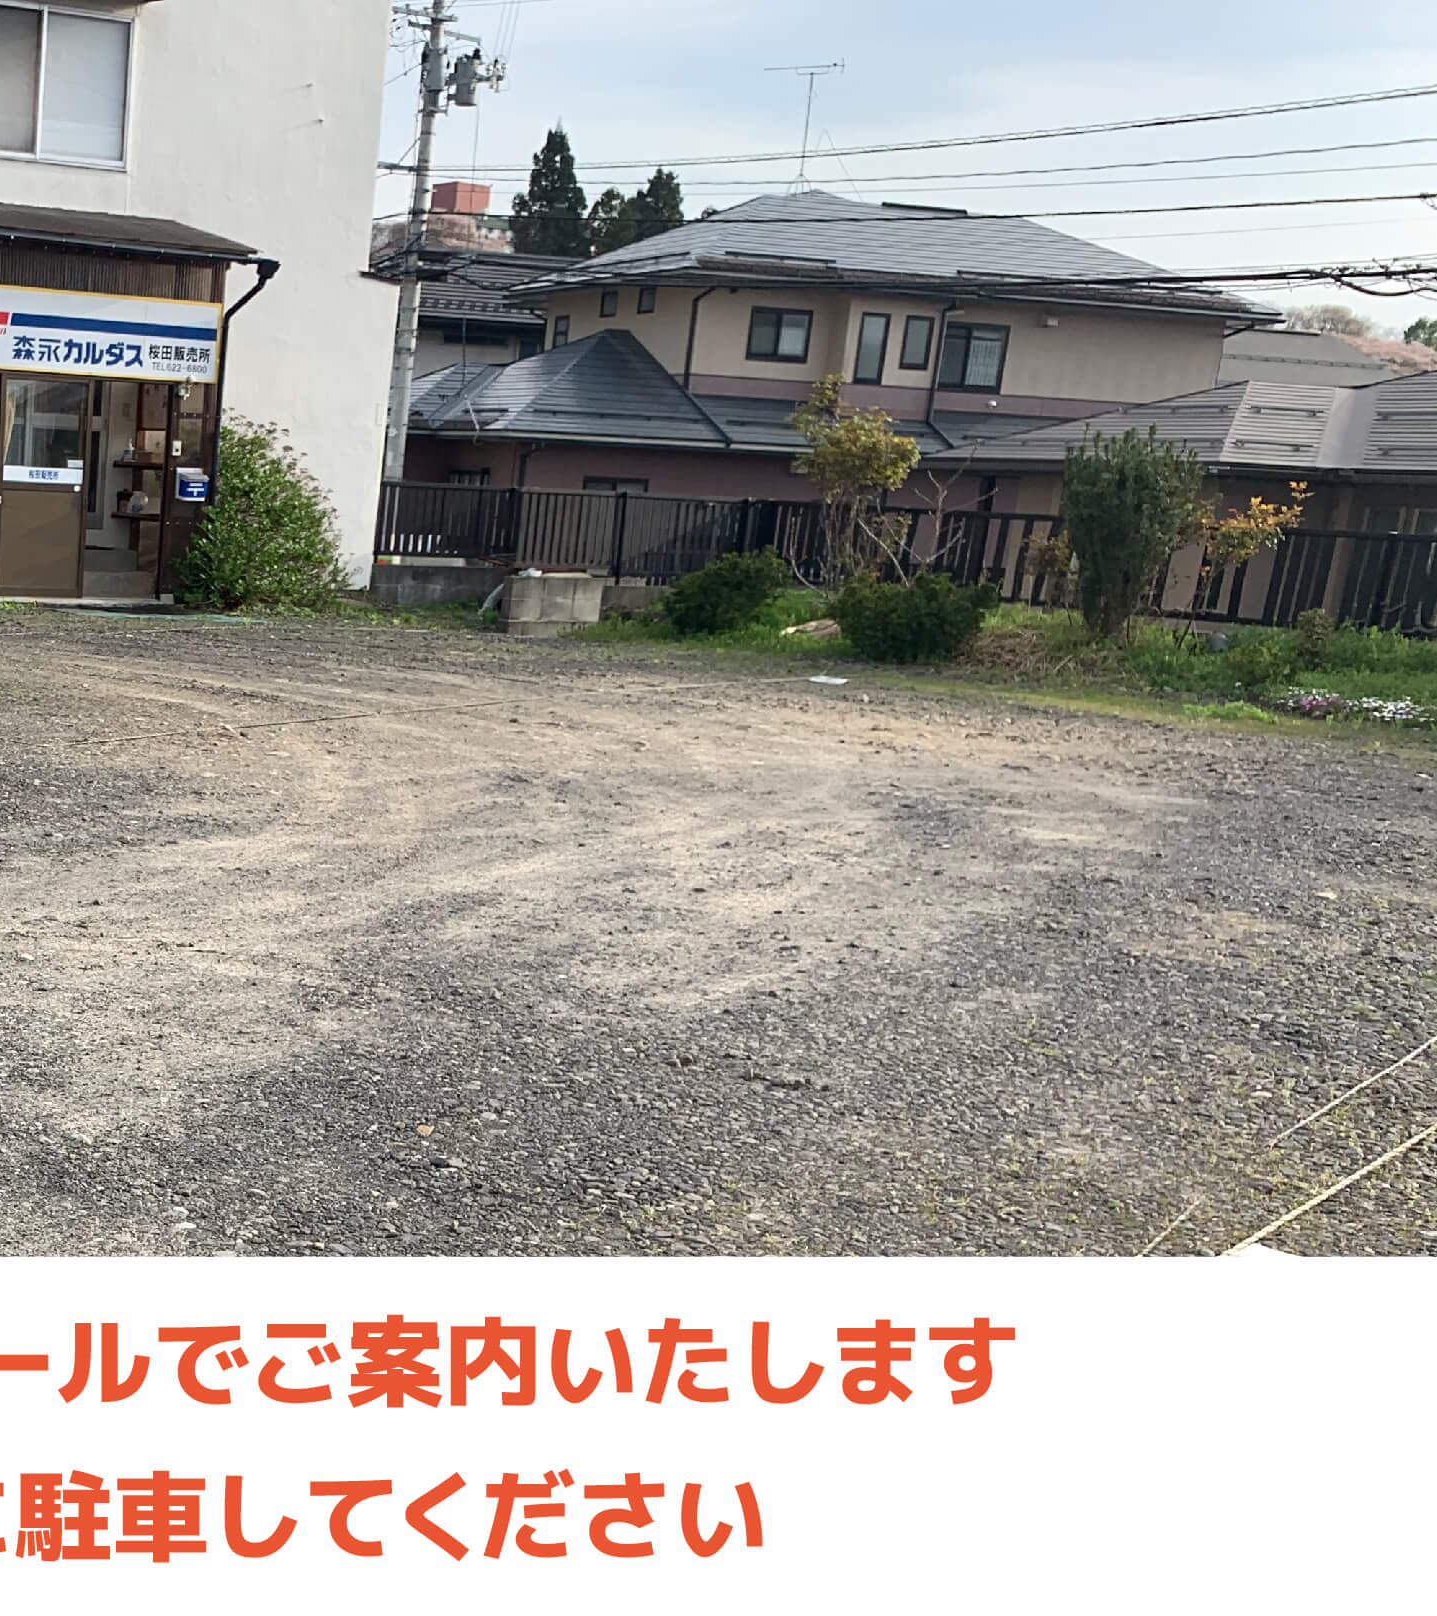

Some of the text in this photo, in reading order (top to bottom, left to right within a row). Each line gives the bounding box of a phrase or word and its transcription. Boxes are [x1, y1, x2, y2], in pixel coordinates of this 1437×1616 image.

[12, 335, 211, 368] 森永カルダス 桜田販売所
